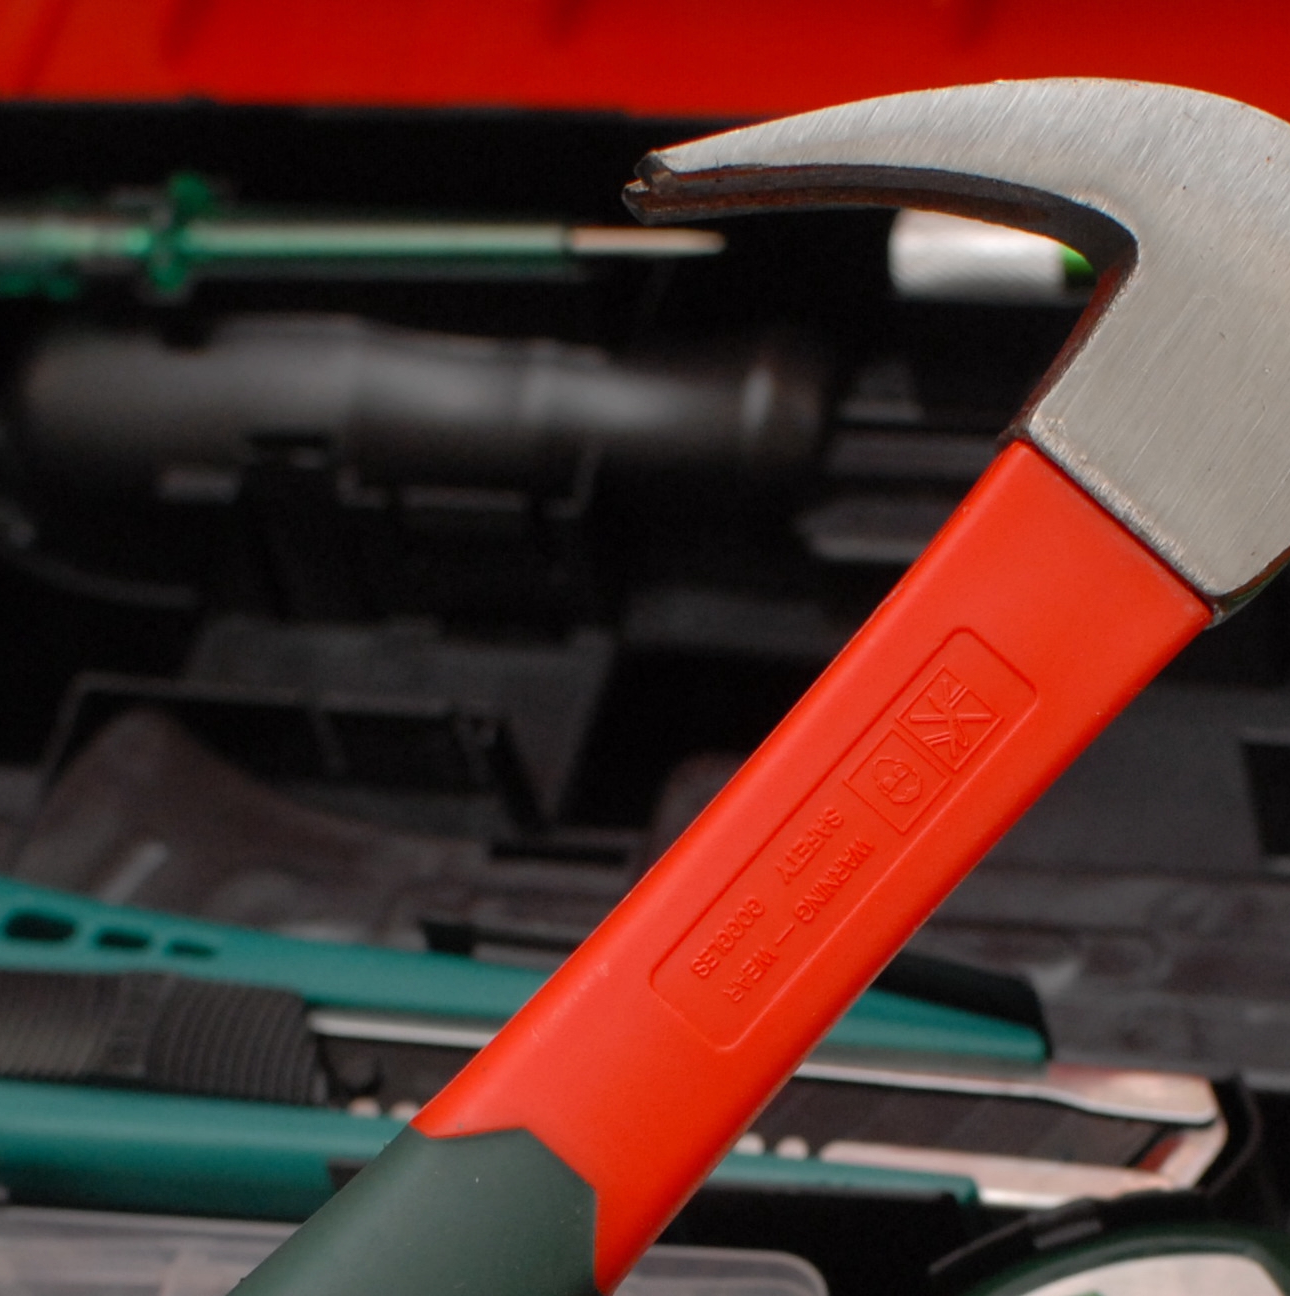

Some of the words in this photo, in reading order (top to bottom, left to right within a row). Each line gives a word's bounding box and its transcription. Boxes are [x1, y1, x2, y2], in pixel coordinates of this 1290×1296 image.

[775, 807, 845, 886] SAFETY
[794, 838, 874, 923] WARNING
[690, 897, 766, 979] GOGGLES
[725, 951, 780, 1004] WEAR
